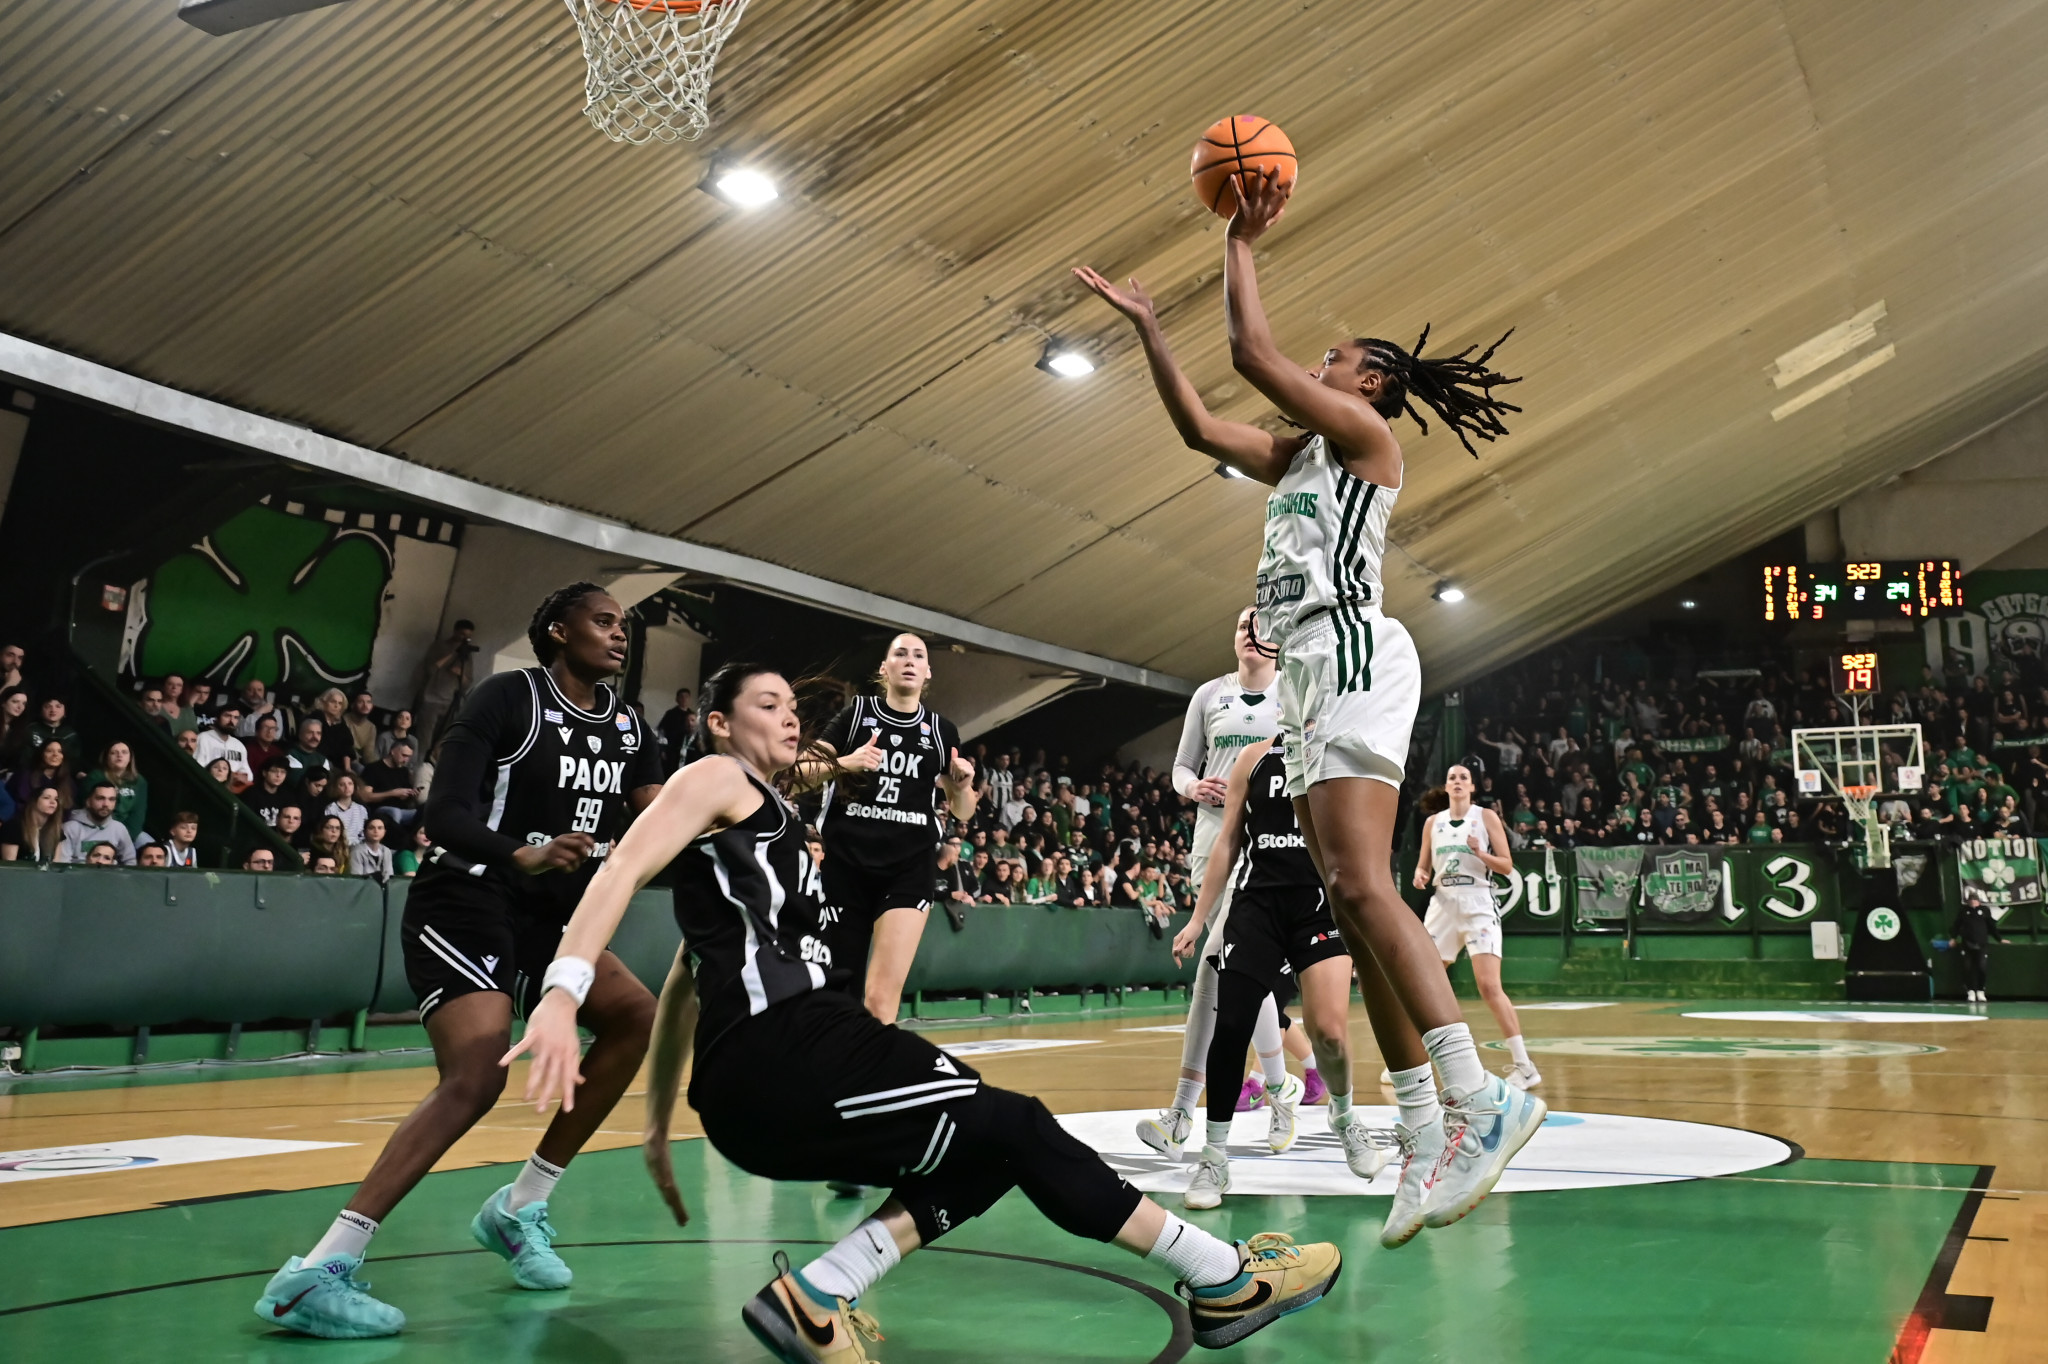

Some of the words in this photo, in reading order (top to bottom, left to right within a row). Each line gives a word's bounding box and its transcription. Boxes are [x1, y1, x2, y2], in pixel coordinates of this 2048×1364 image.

[1847, 563, 1881, 580] 5:23
[1926, 561, 1934, 572] 3
[1799, 591, 1807, 602] 2
[1814, 584, 1837, 601] 34
[1854, 586, 1865, 600] 2
[1886, 582, 1910, 599] 29
[1900, 603, 1912, 616] 4
[1928, 597, 1937, 607] 2
[1812, 605, 1823, 619] 3
[1842, 653, 1876, 670] 5:23
[1848, 669, 1872, 690] 19
[864, 749, 924, 779] AOK
[558, 755, 626, 794] PAOK
[875, 776, 902, 804] 25
[571, 797, 603, 833] 99
[846, 802, 928, 826] Stoiximan
[1257, 833, 1306, 849] Stoix
[1446, 858, 1460, 873] 22
[797, 849, 826, 904] PA
[2019, 882, 2038, 900] 13
